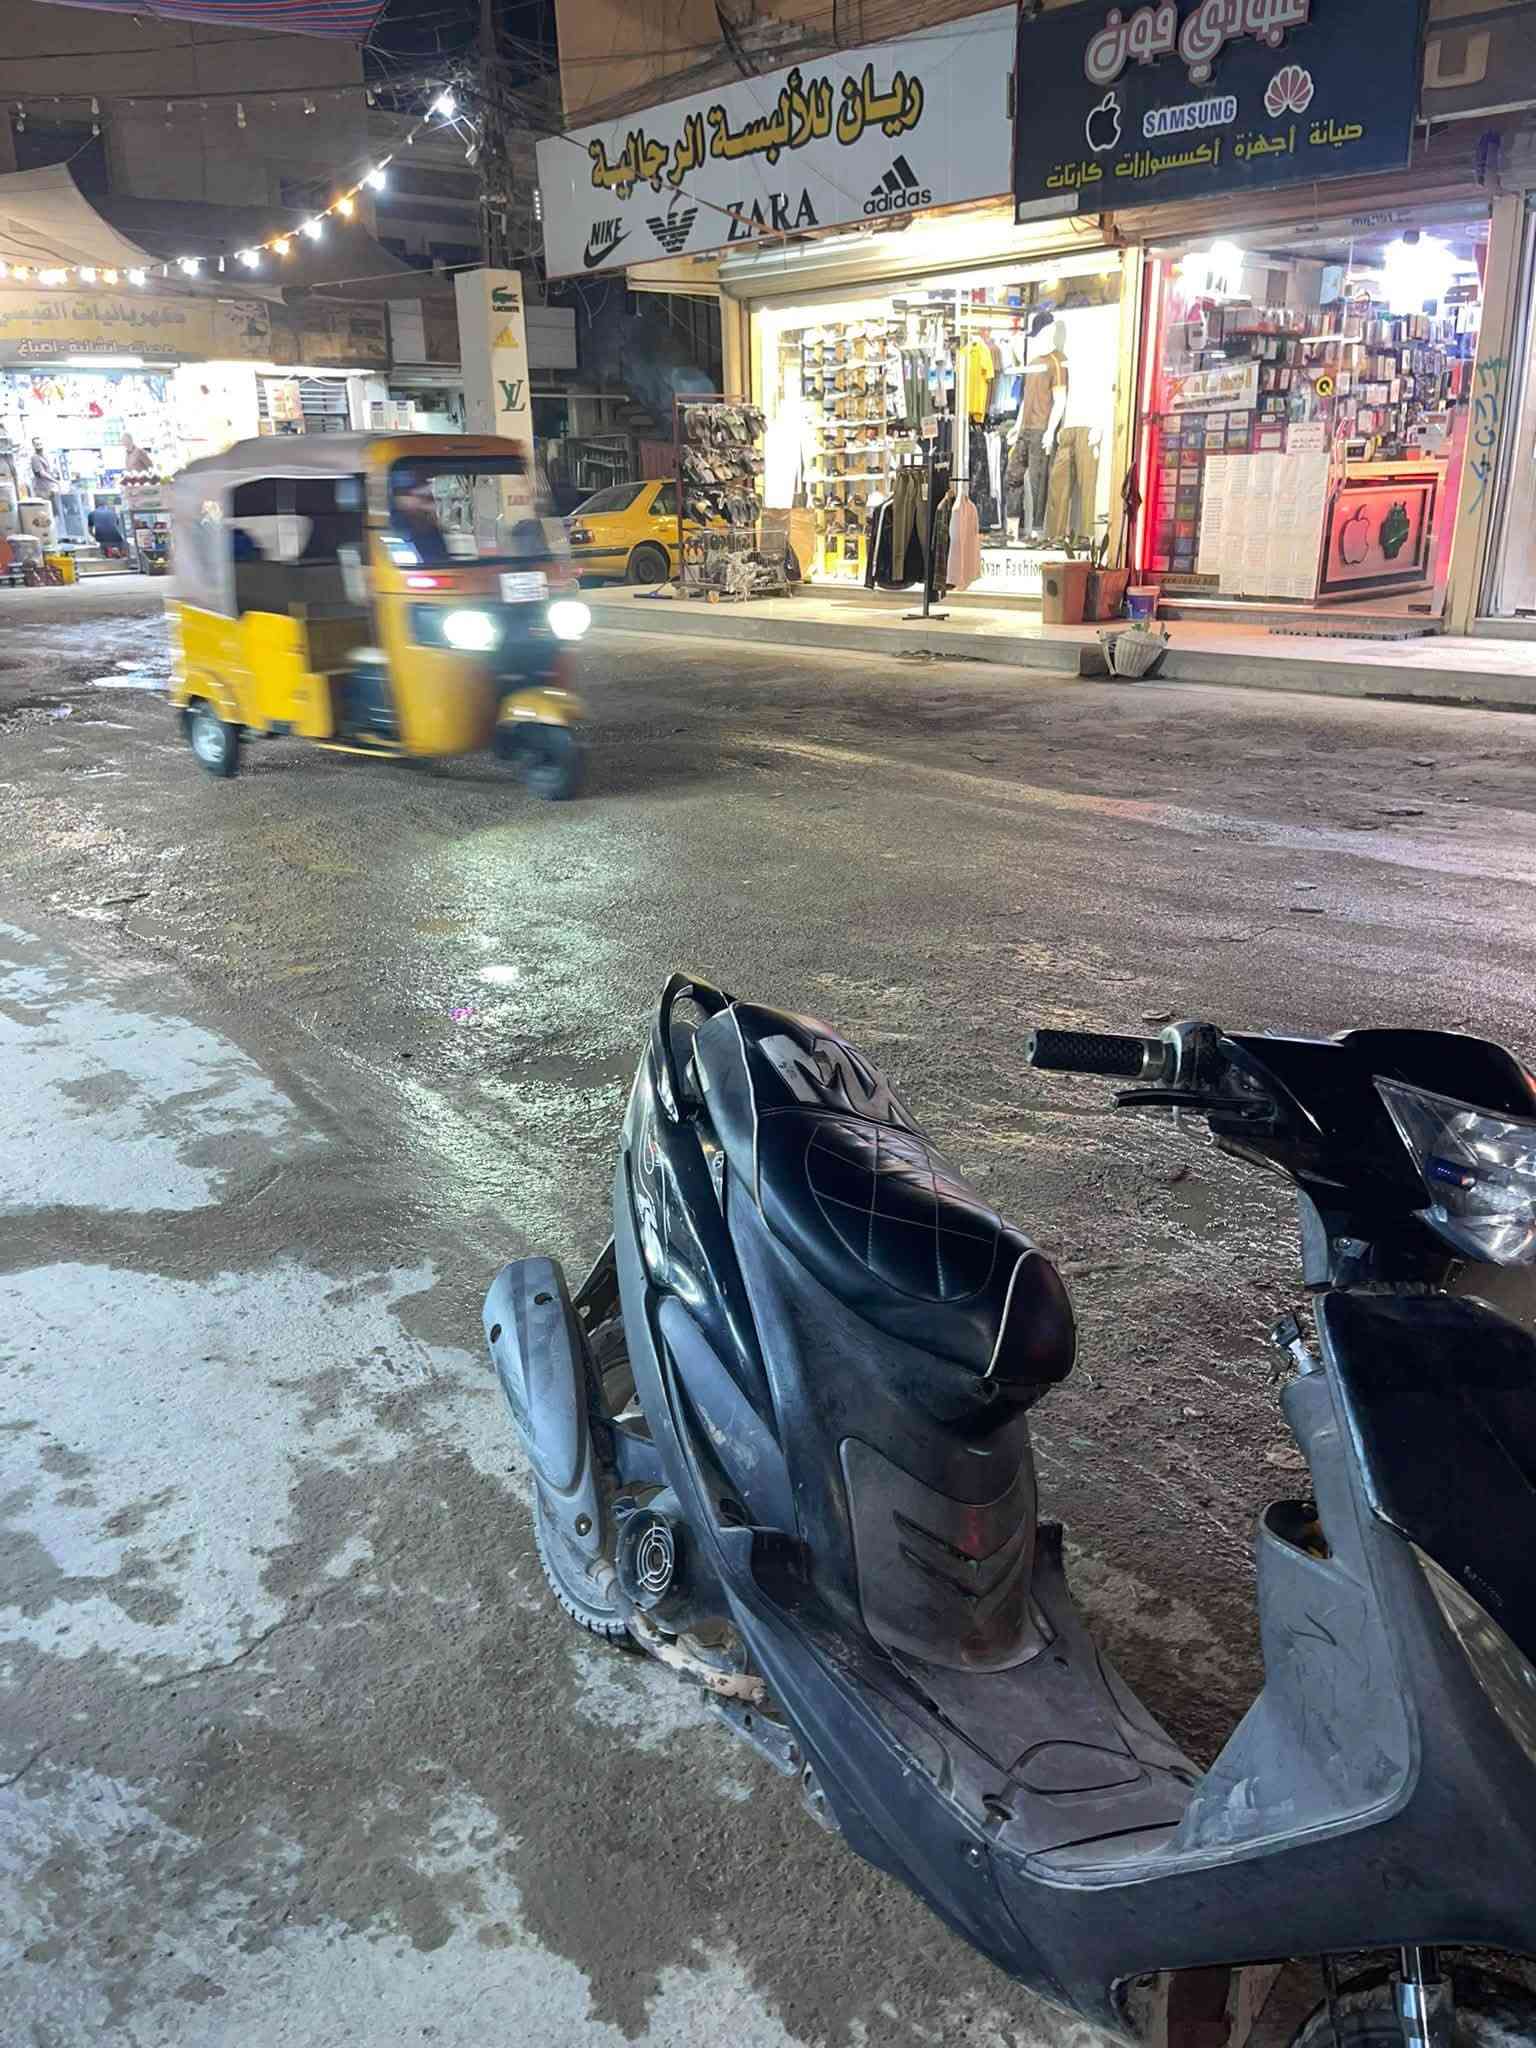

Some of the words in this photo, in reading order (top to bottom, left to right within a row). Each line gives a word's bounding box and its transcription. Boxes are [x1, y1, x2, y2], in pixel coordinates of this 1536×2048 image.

[1085, 8, 1178, 85] فون
[706, 66, 834, 166] للألبسة
[836, 62, 924, 145] ريان
[1143, 96, 1237, 138] SAMSUNG
[588, 111, 706, 200] الرجالية
[1309, 119, 1363, 148] صيانة
[1045, 160, 1103, 189] كارتات
[726, 188, 819, 242] ZARA
[863, 187, 932, 215] adidas
[590, 217, 623, 247] NIKE
